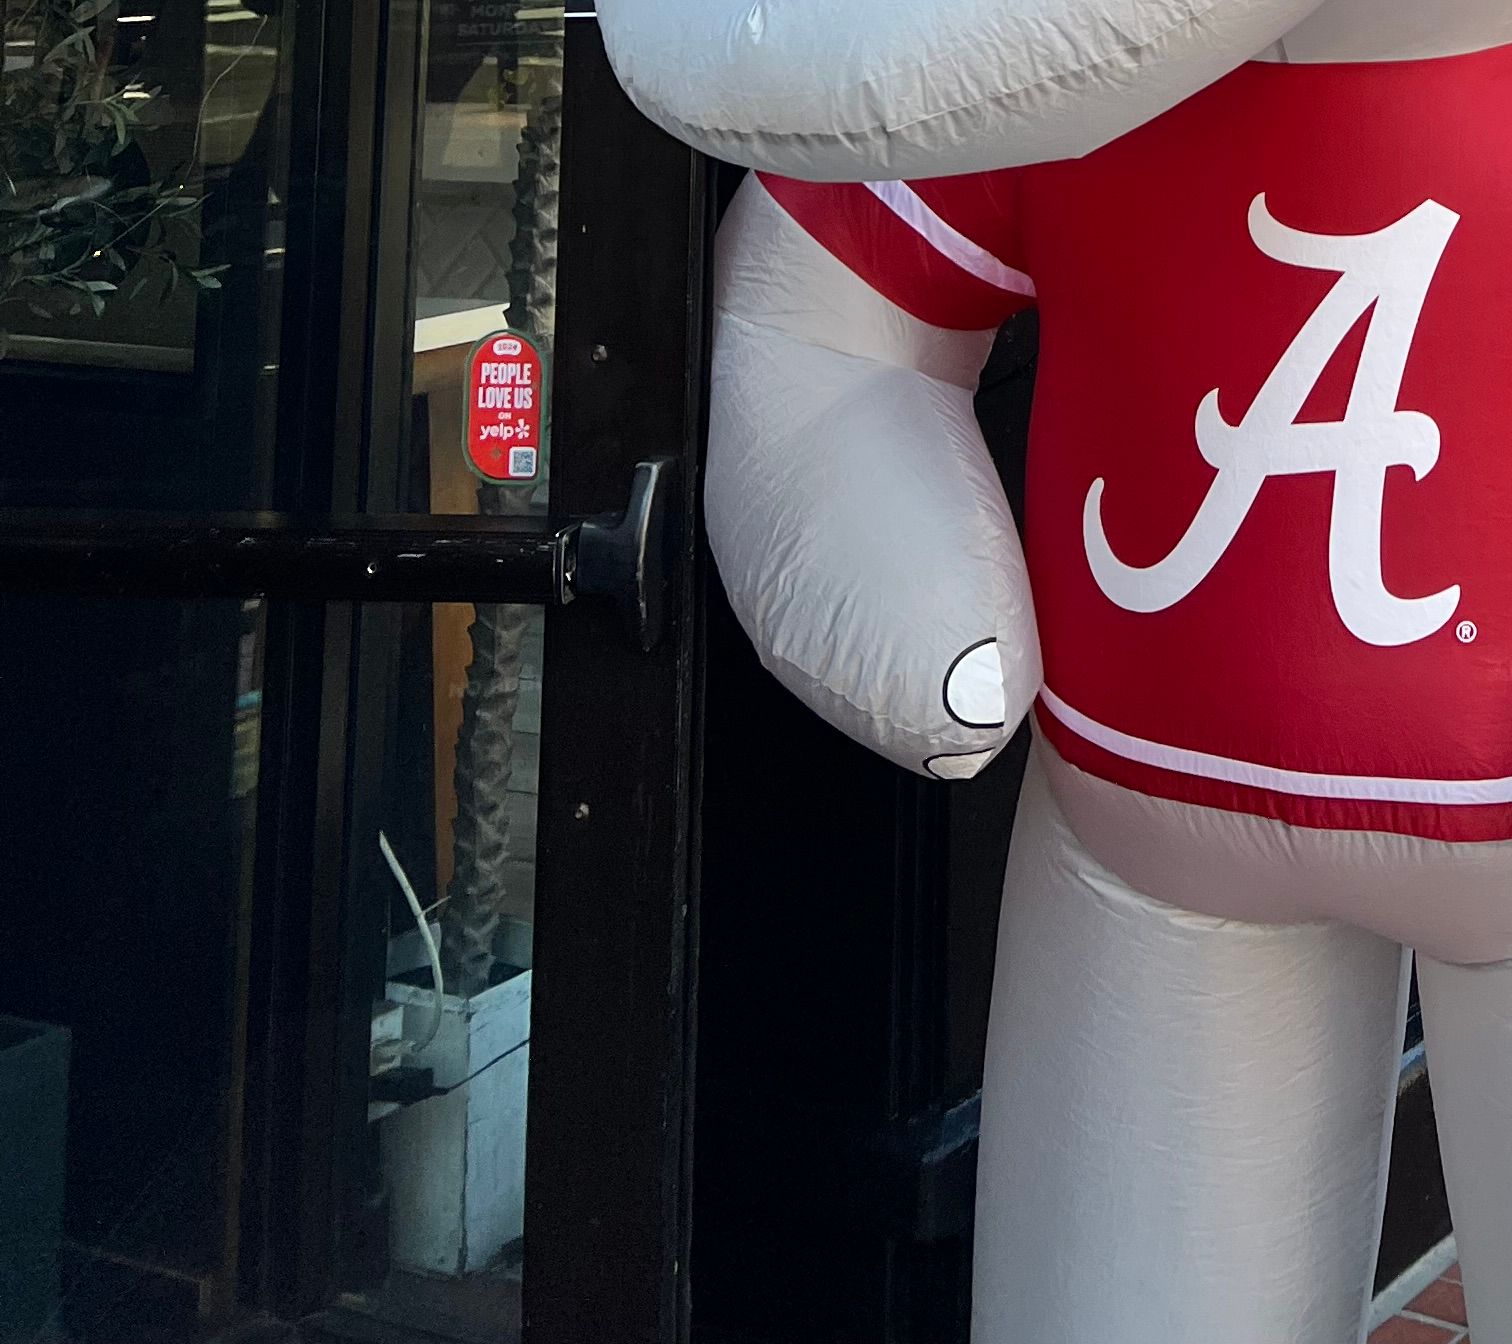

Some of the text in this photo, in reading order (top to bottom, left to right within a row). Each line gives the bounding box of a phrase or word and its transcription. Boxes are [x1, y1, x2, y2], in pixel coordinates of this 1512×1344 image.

[481, 363, 532, 385] PEOPLE
[478, 387, 533, 409] LOVE US
[1083, 192, 1461, 647] A
[480, 423, 514, 441] yelp
